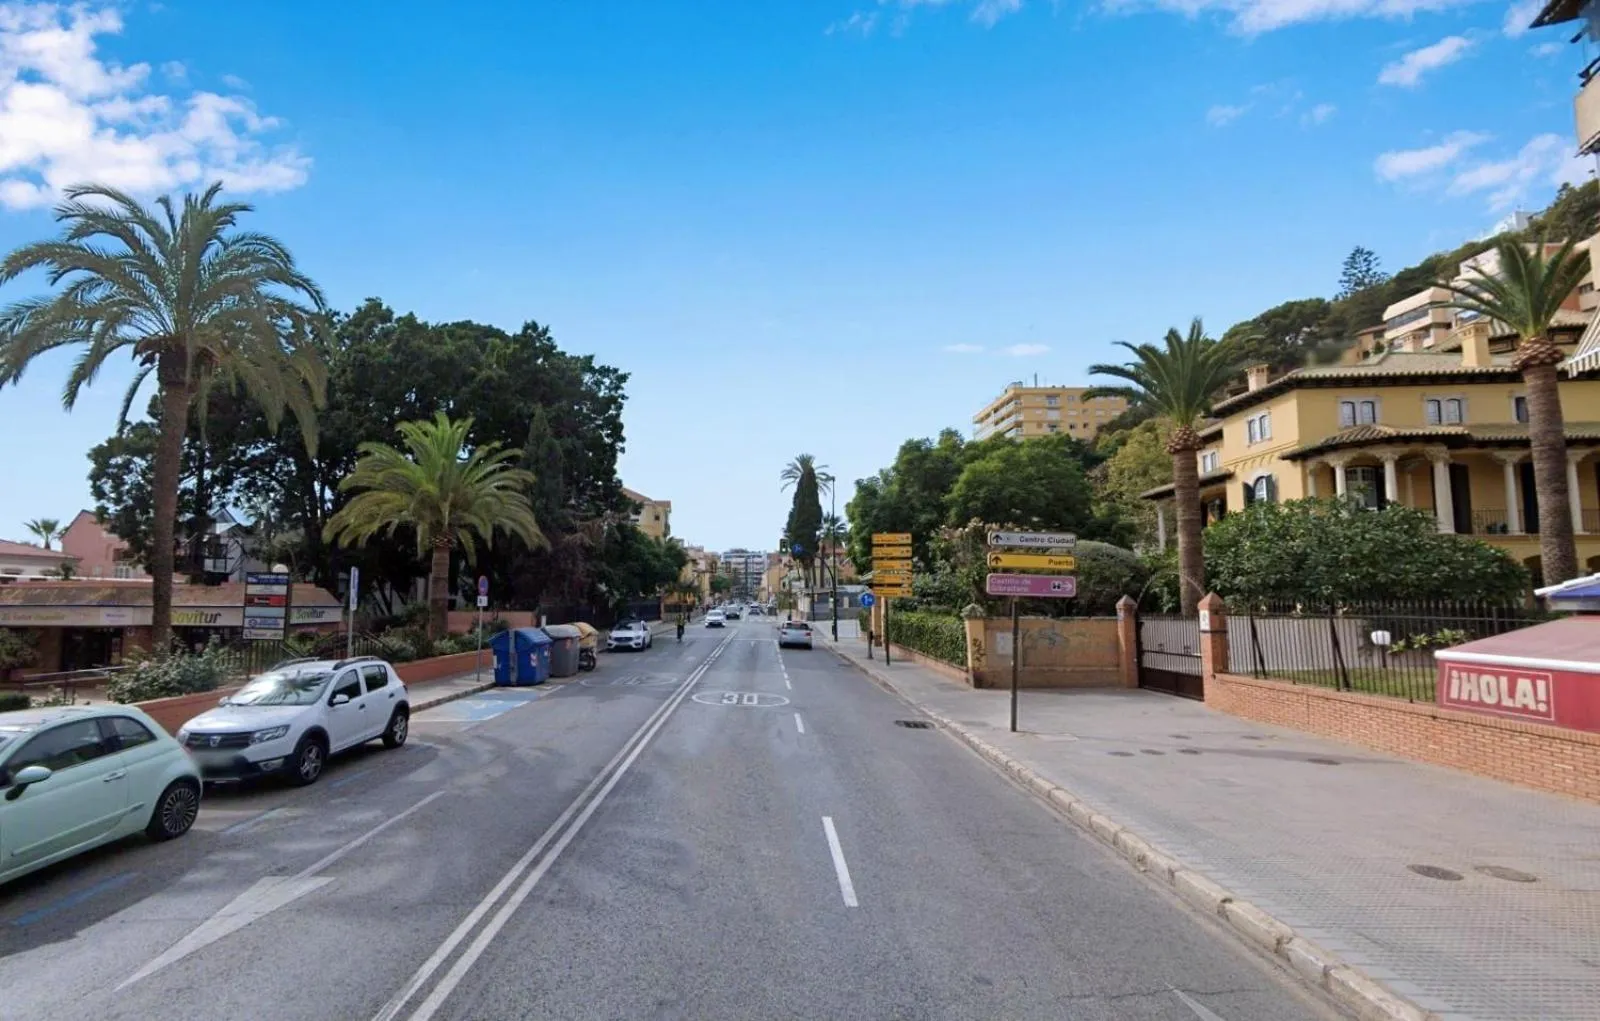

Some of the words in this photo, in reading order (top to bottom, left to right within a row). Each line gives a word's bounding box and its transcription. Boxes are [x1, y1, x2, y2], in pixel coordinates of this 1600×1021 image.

[1047, 536, 1074, 544] Ciudad
[1048, 558, 1073, 566] Puerto
[1449, 669, 1548, 712] ¡HOLA!
[722, 692, 759, 705] 30
